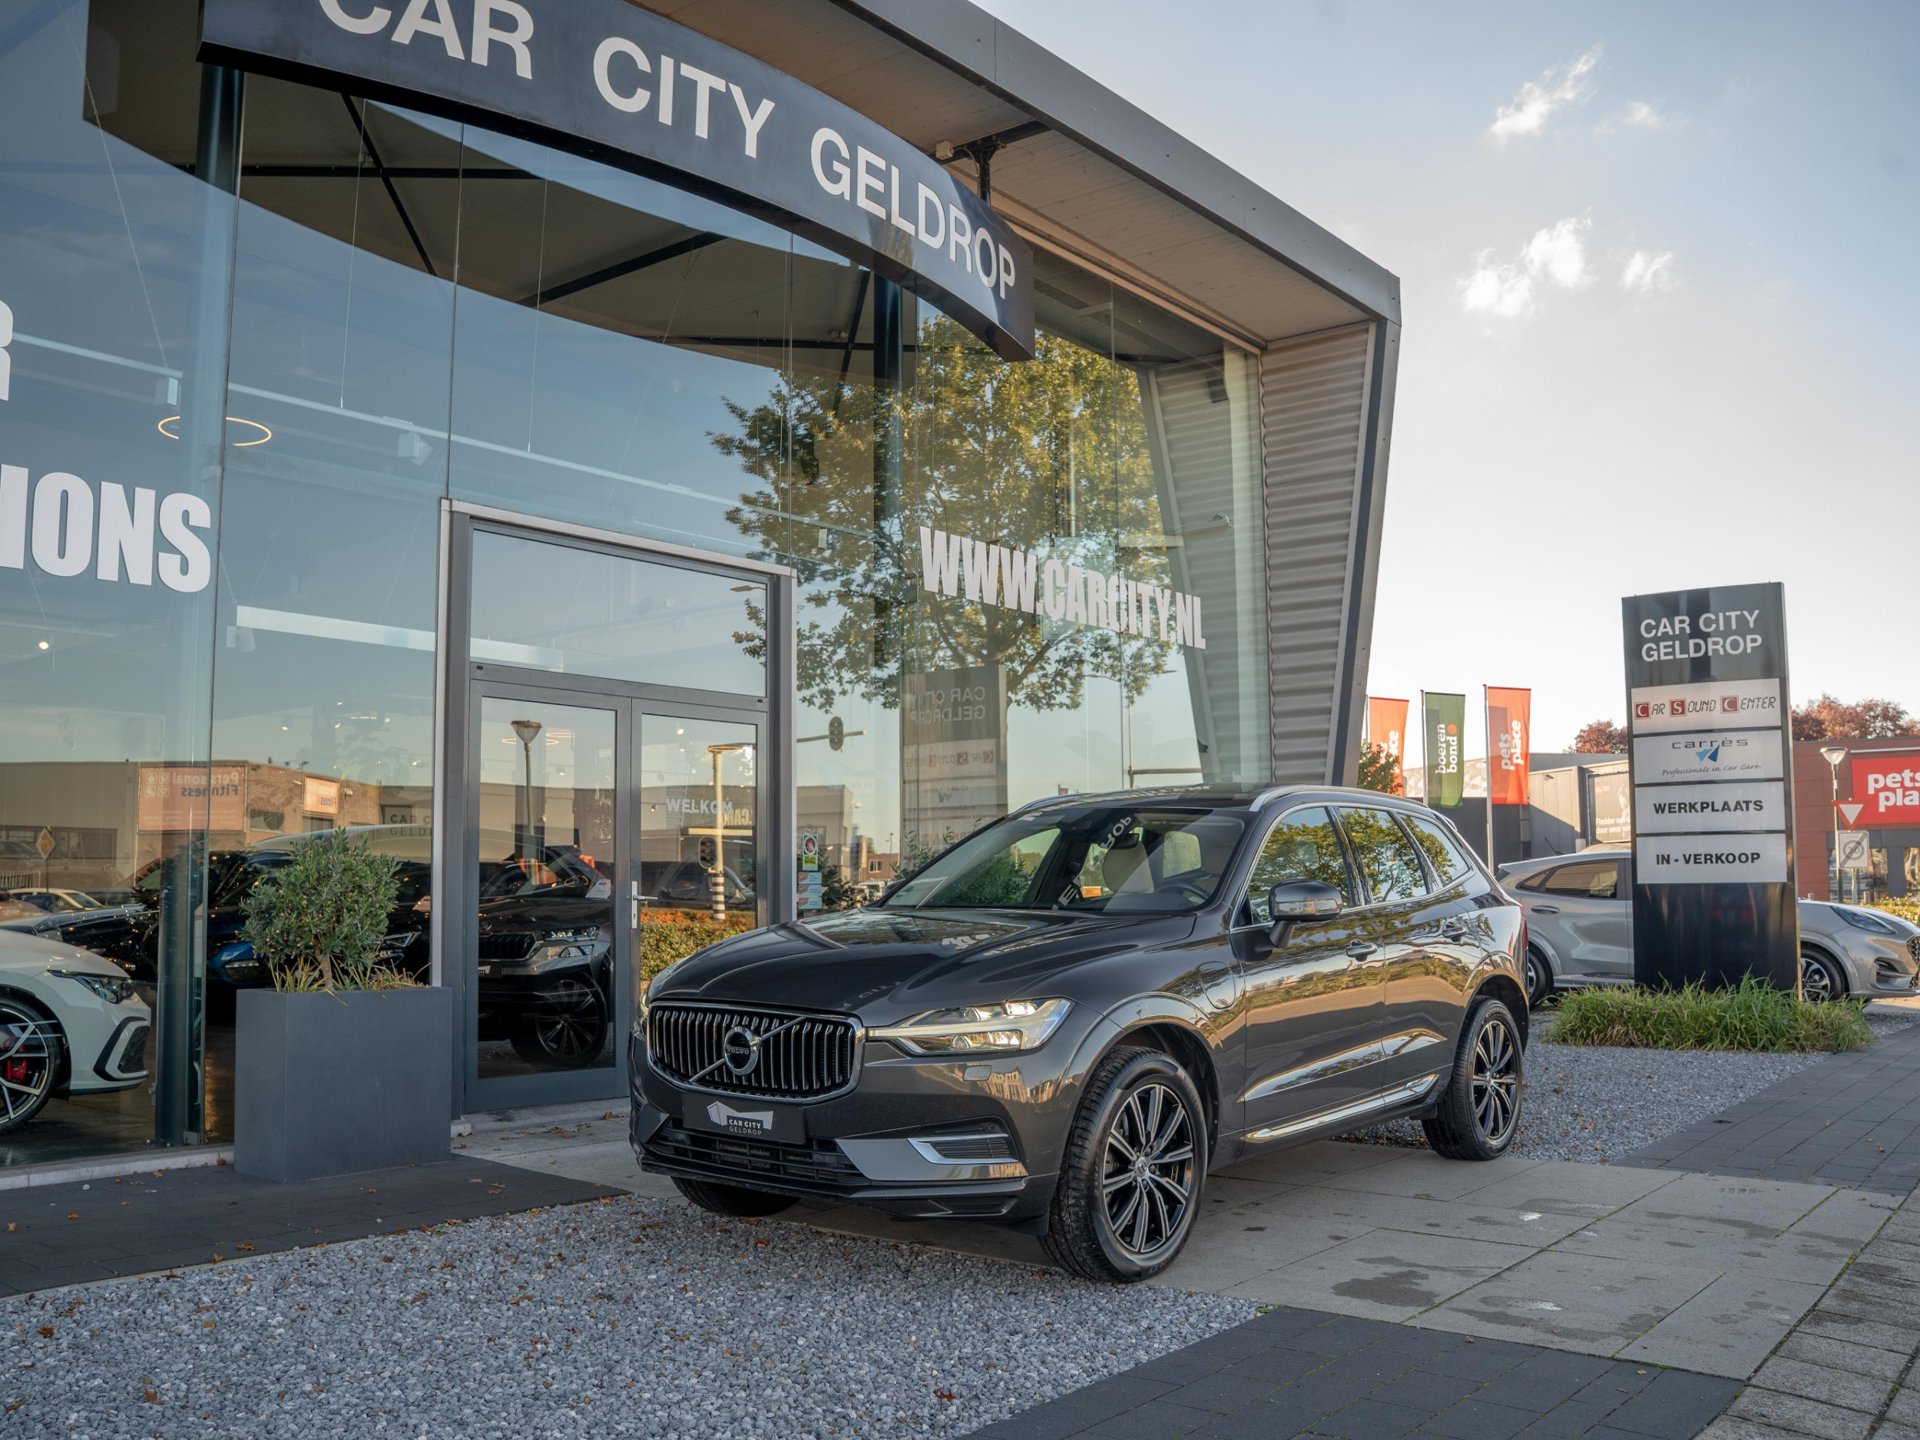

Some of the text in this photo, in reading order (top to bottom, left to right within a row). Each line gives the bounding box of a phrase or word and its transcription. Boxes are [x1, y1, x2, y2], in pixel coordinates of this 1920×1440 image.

[593, 36, 776, 159] CITY
[810, 127, 1016, 300] GELDROP
[0, 463, 212, 593] IONS
[919, 525, 1206, 650] WWW.CARCITY.NL
[1640, 609, 1760, 638] CAR CITY
[1641, 634, 1763, 662] GELDROP
[1634, 695, 1776, 720] CAR SOUND CENTER
[1435, 724, 1446, 775] boeren
[1446, 736, 1458, 773] bond
[1499, 733, 1515, 770] pets
[1511, 719, 1524, 765] place
[1672, 737, 1748, 750] carrès
[666, 799, 733, 814] WELKOM
[1653, 800, 1764, 814] WERKPLAATS
[1656, 854, 1670, 865] IN
[1682, 852, 1761, 865] VERKOOP
[728, 1119, 762, 1129] CAR CITY
[729, 1126, 762, 1136] GELDROP
